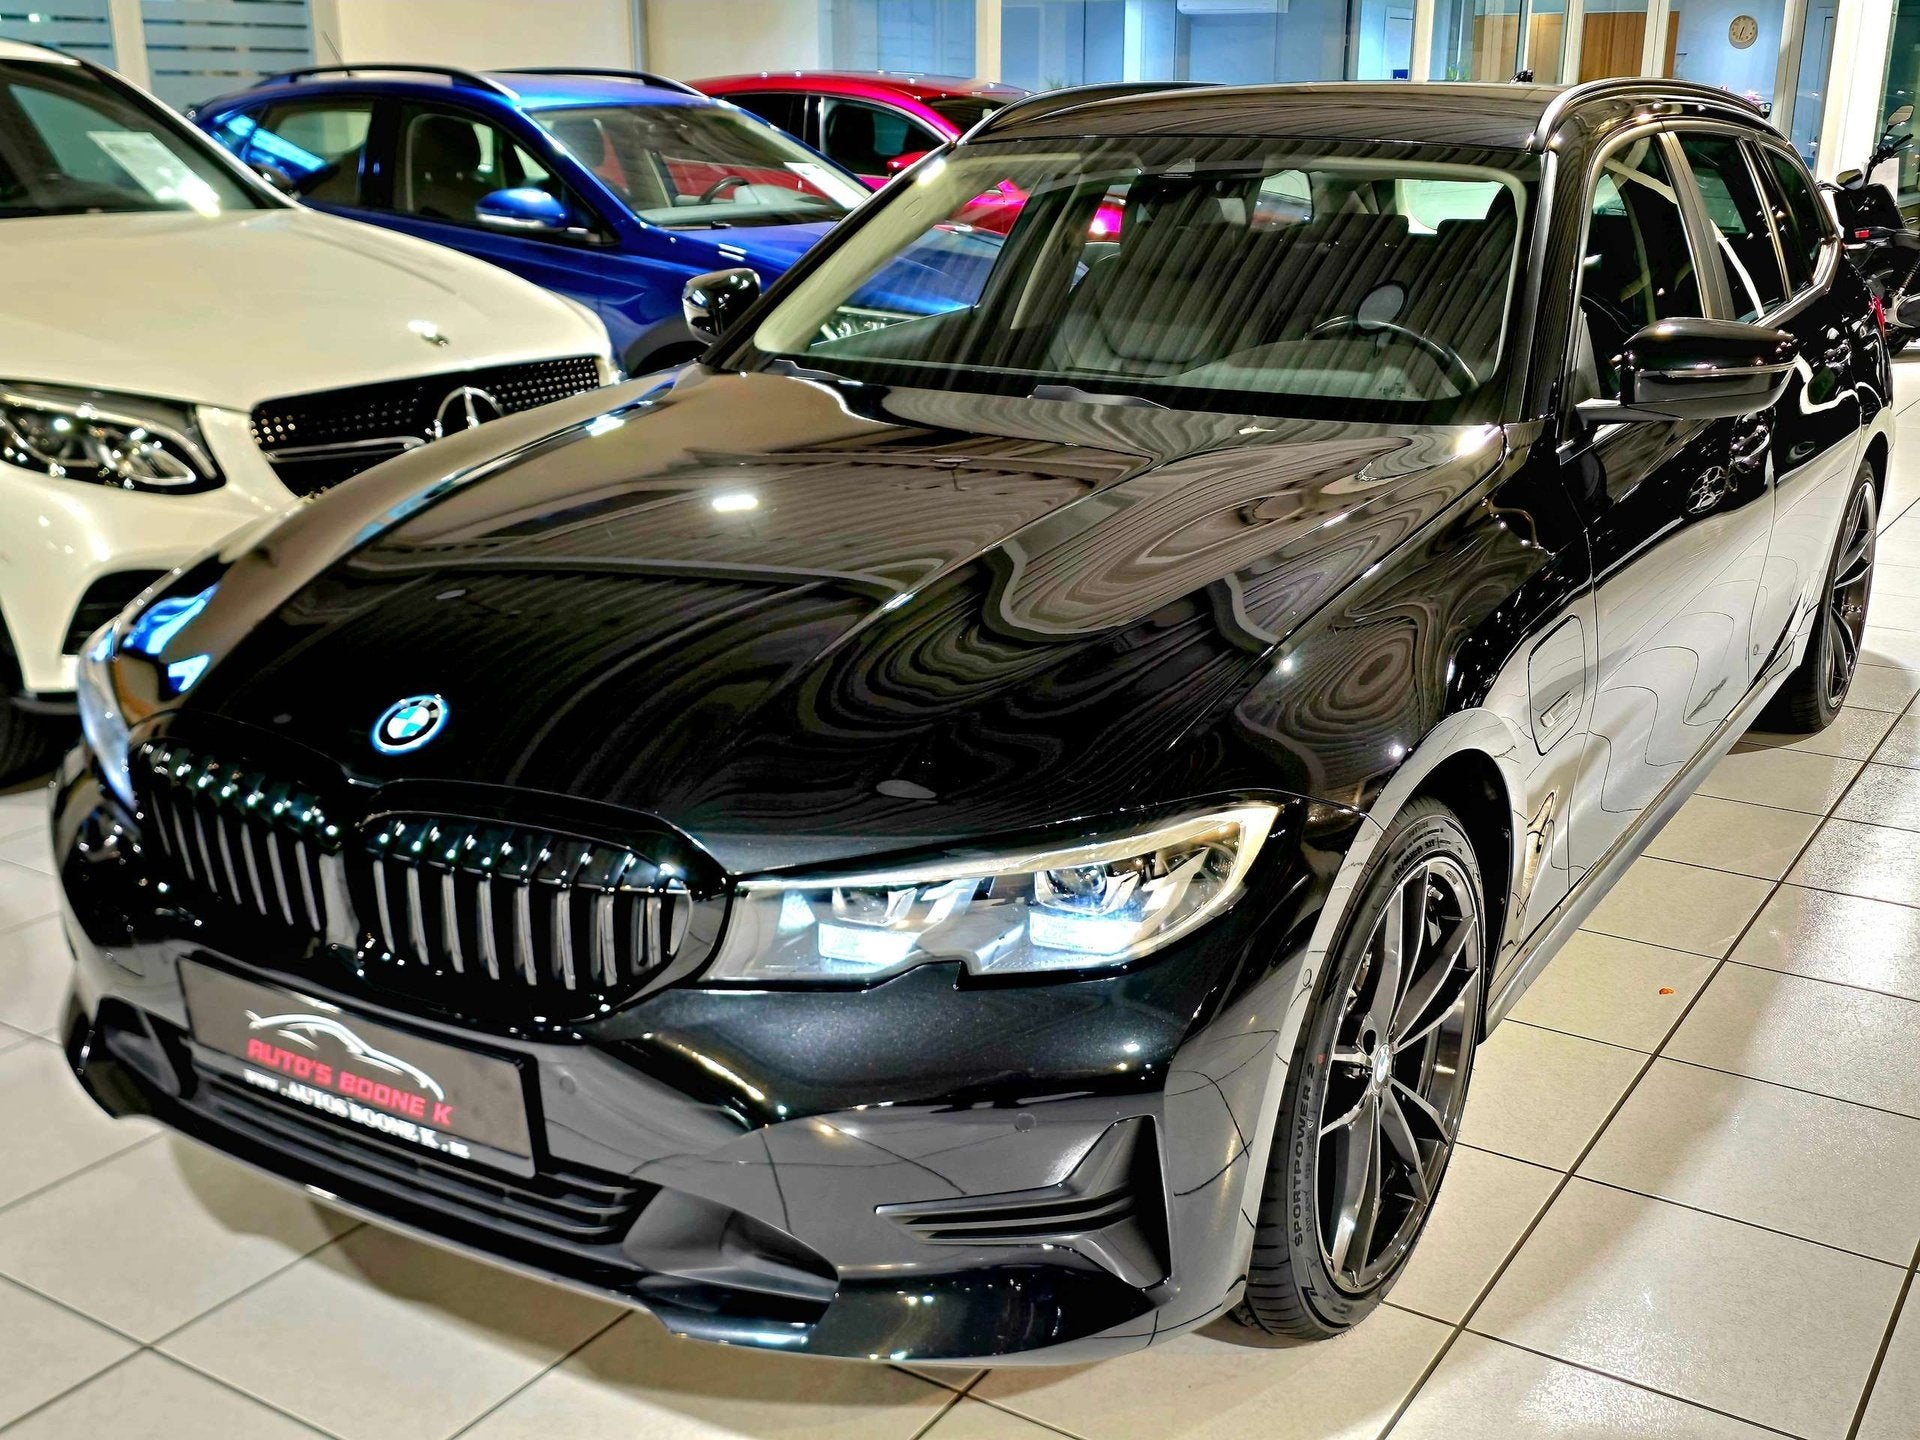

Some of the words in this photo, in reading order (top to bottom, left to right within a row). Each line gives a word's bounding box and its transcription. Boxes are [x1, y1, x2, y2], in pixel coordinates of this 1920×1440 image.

[247, 1038, 332, 1086] AUTO'S
[338, 1071, 426, 1118] BOONE
[432, 1101, 454, 1126] K
[1294, 1085, 1312, 1247] SPORTPOWER
[1306, 1062, 1315, 1078] 2
